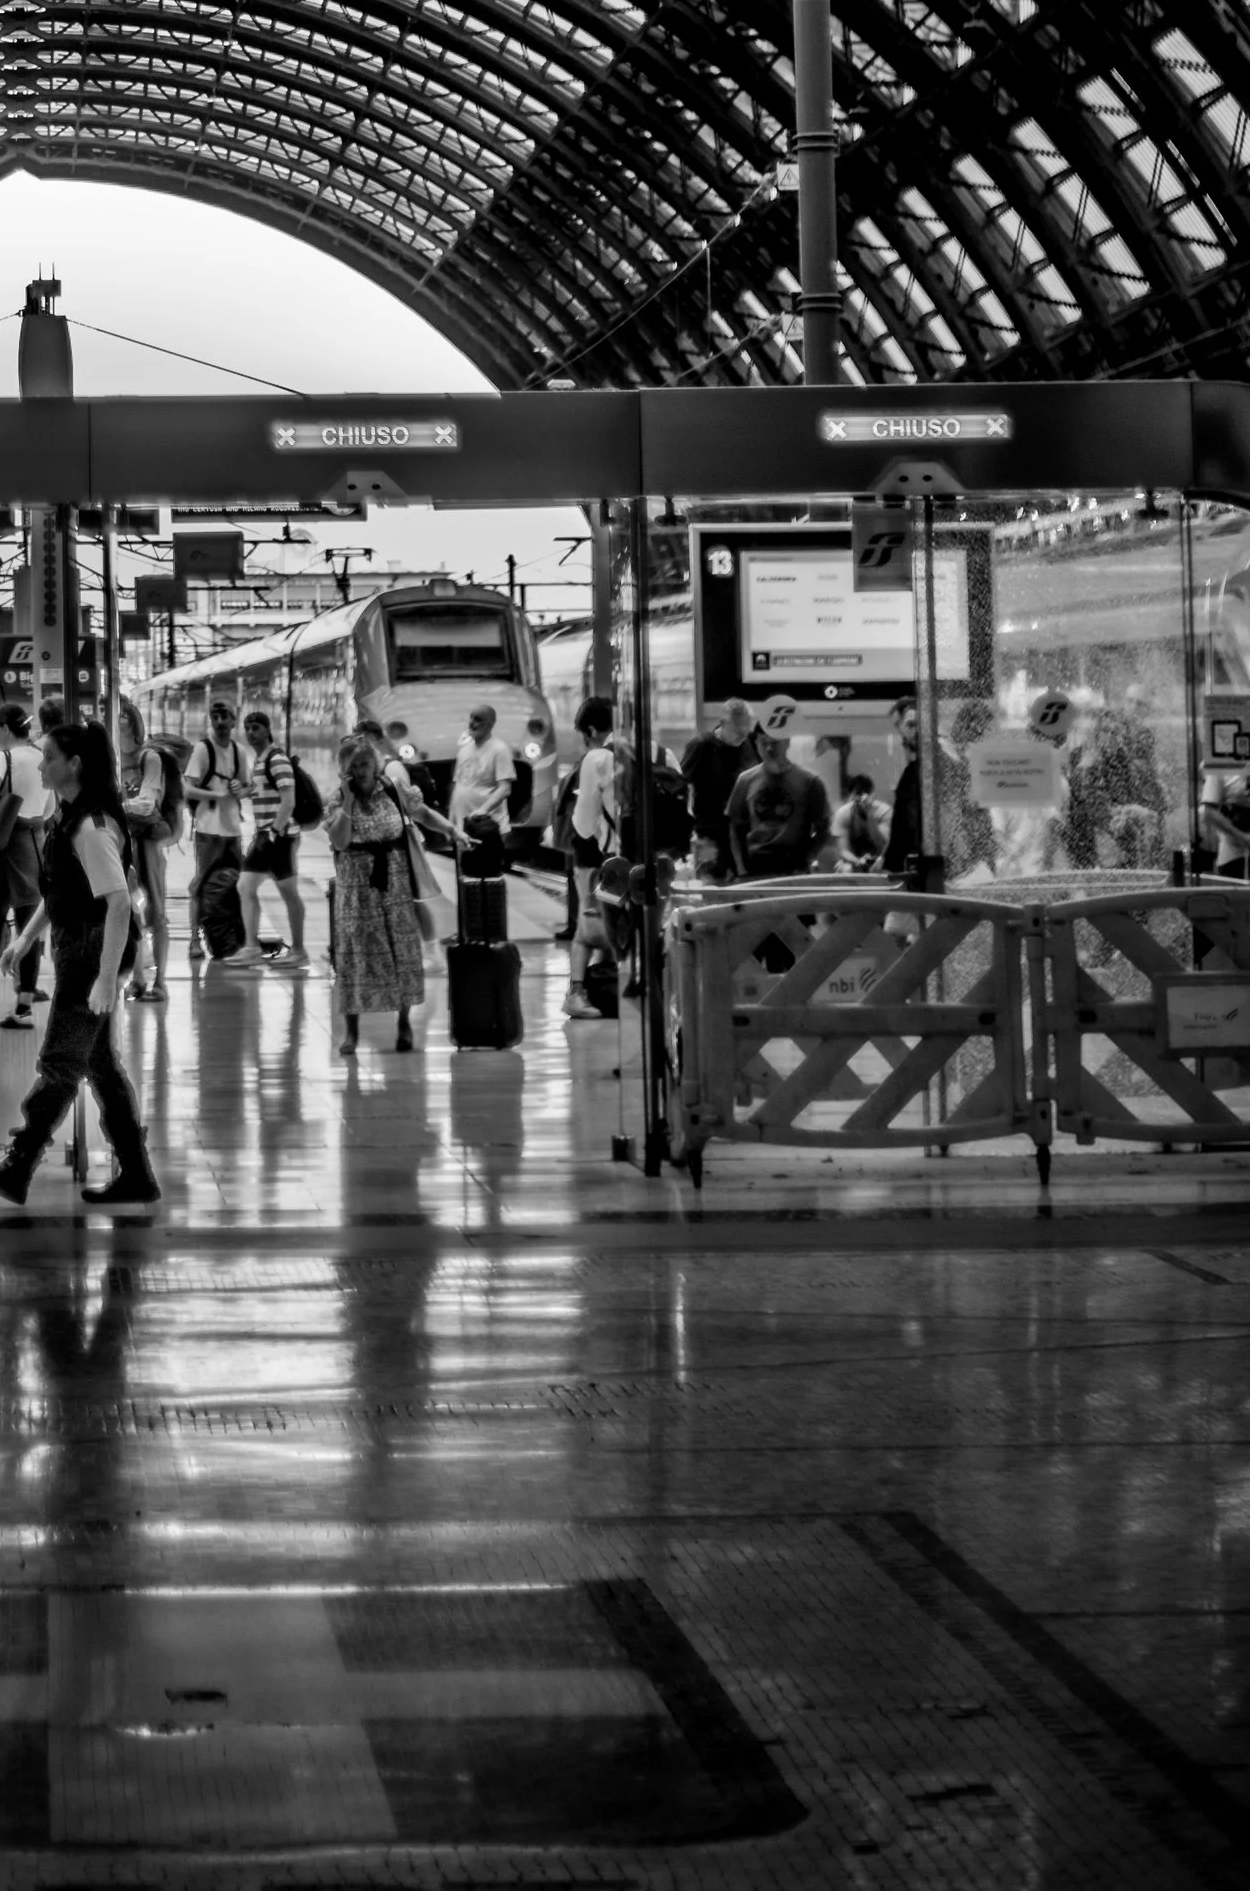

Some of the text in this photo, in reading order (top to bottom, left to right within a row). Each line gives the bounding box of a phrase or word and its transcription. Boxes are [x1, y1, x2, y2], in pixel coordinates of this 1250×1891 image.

[321, 426, 410, 446] CHIUSO
[871, 418, 961, 438] CHIUSO
[708, 550, 733, 575] 13
[829, 977, 855, 994] nbi
